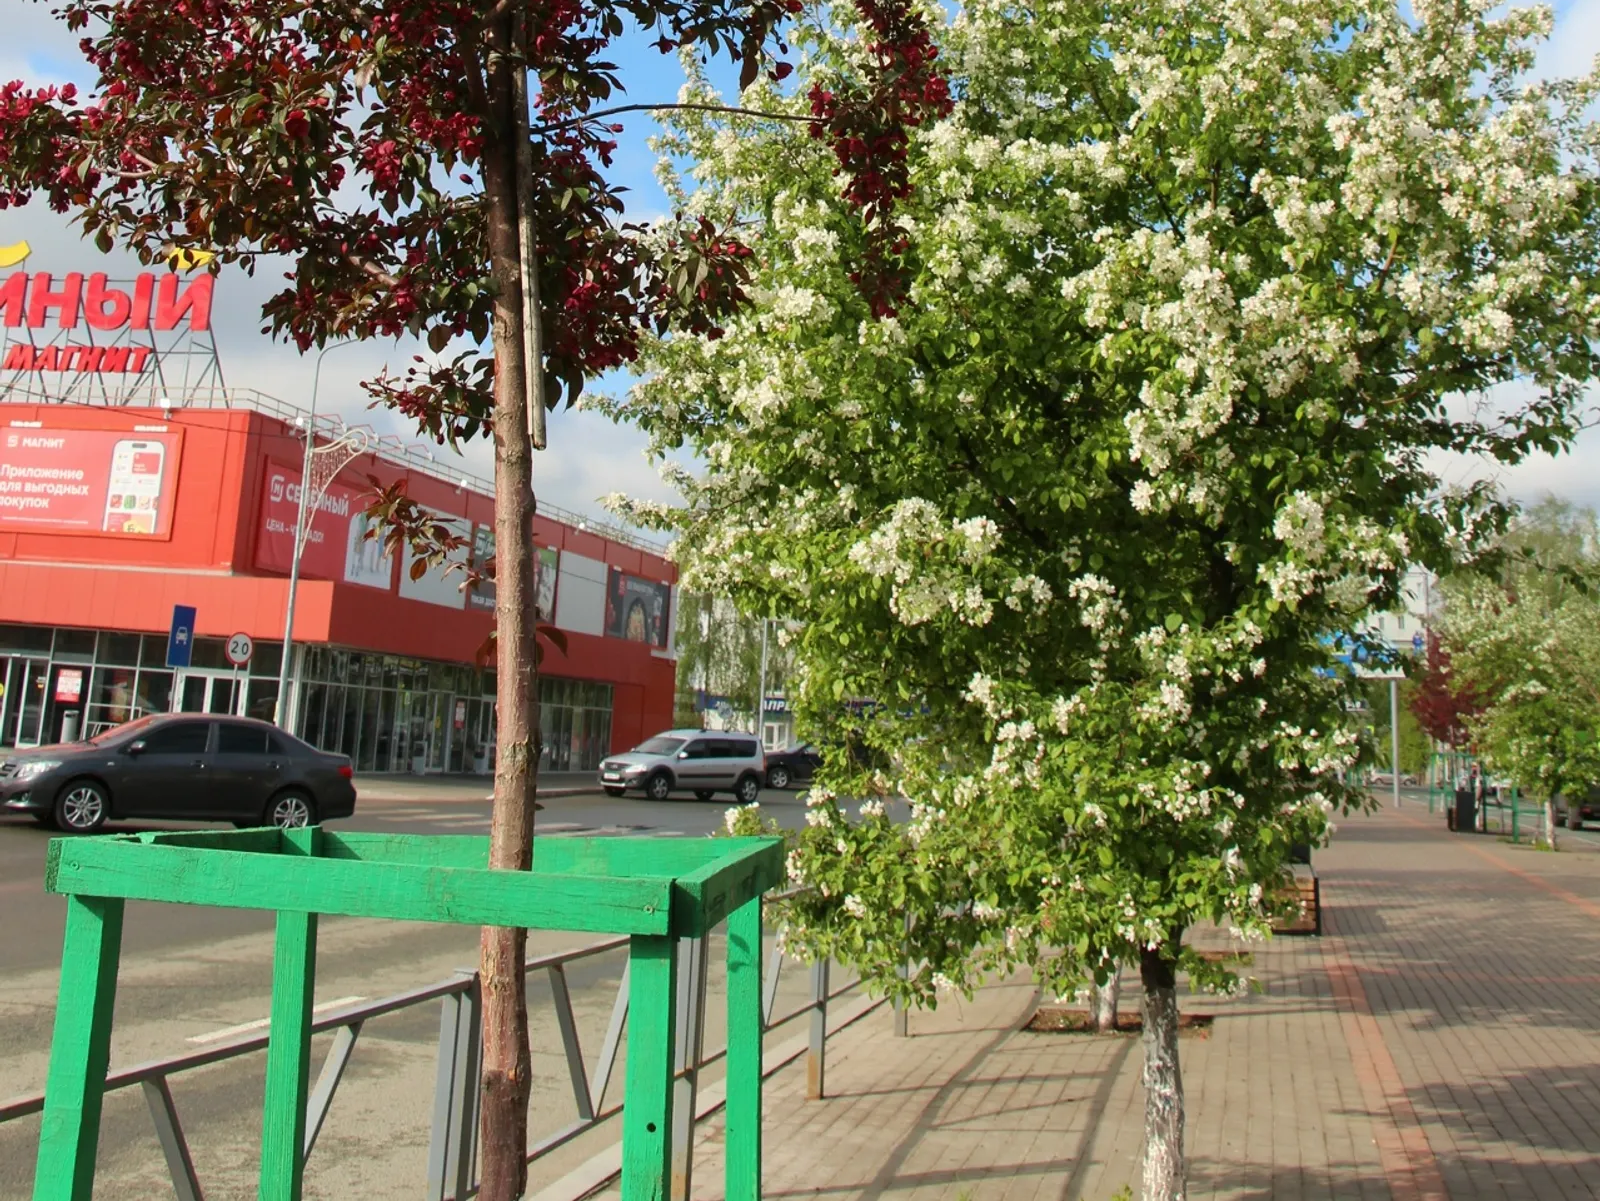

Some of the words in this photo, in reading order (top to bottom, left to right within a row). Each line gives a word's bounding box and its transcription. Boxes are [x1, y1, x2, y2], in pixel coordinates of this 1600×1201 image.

[3, 344, 153, 373] МАГНИТ
[22, 437, 66, 449] МАГНИТ
[1, 464, 85, 481] Приложение
[24, 482, 90, 497] выгодных
[231, 641, 249, 655] 20
